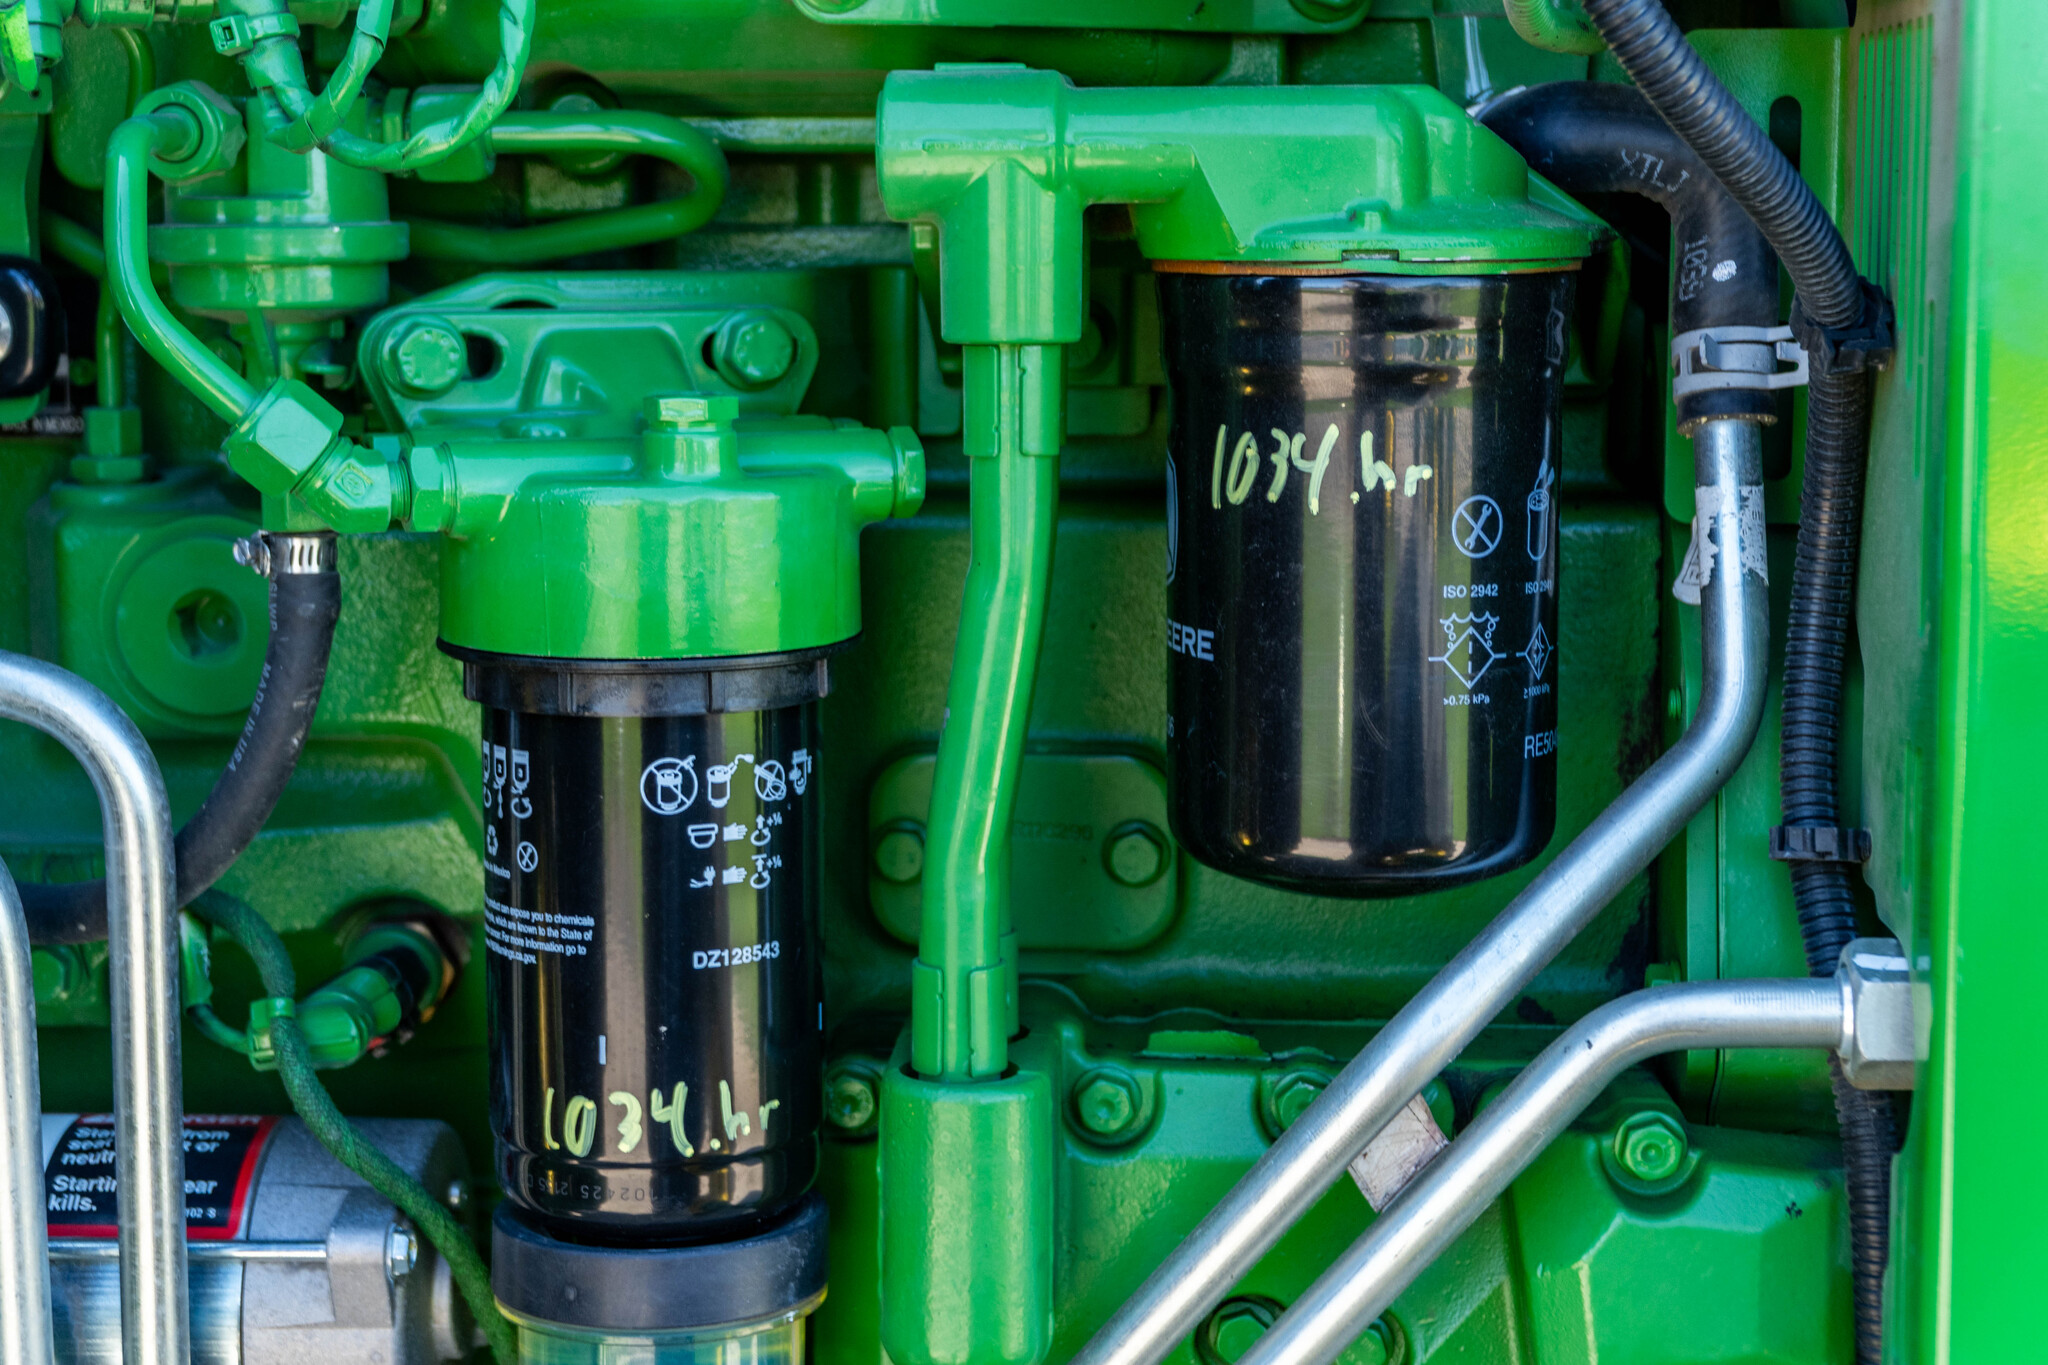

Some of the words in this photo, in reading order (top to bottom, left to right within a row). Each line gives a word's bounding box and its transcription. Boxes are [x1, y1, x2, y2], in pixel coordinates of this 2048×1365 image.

[1443, 585, 1468, 599] ISO
[1470, 583, 1499, 598] 2942
[1525, 581, 1539, 595] ISO
[251, 663, 272, 716] MADE
[1472, 692, 1491, 705] kPa
[244, 716, 256, 738] IN
[228, 738, 248, 772] USA
[510, 907, 530, 919] expose
[531, 911, 544, 923] you
[545, 912, 553, 923] to
[554, 913, 595, 927] chemicals
[517, 921, 537, 935] known
[538, 926, 546, 936] to
[547, 926, 559, 938] the
[560, 927, 582, 940] State
[583, 929, 593, 941] of
[510, 936, 524, 947] more
[525, 937, 564, 953] information
[565, 945, 577, 957] go
[577, 944, 587, 956] to
[692, 940, 780, 970] DZ128543
[183, 1129, 230, 1141] from
[194, 1141, 221, 1152] or
[60, 1149, 116, 1166] neutr
[53, 1174, 117, 1192] Startin
[184, 1179, 218, 1194] ear
[48, 1194, 97, 1212] kills.
